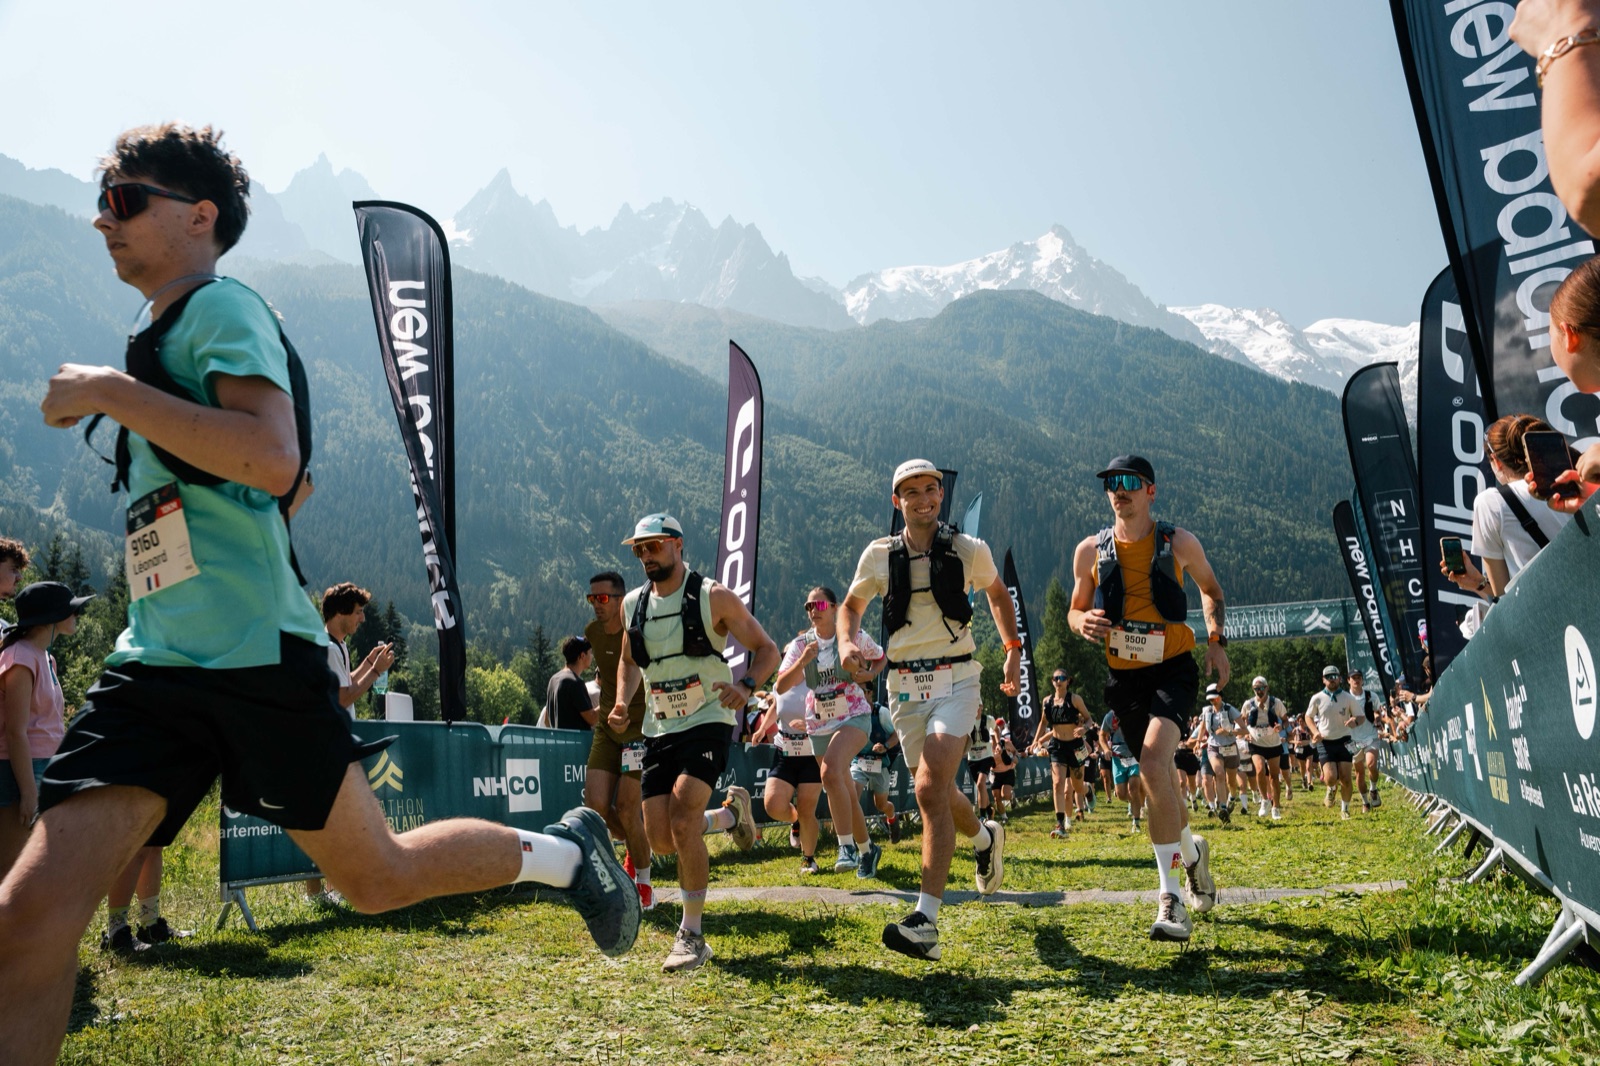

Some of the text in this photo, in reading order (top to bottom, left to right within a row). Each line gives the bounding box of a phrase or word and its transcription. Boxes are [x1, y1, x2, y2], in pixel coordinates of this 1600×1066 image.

[1444, 0, 1537, 112] ew
[1389, 499, 1406, 517] N
[131, 530, 160, 557] 9160
[1399, 538, 1415, 557] H
[133, 549, 168, 576] Léonard
[1345, 536, 1370, 580] new
[1408, 578, 1423, 596] C
[1124, 635, 1147, 645] 9500
[914, 673, 934, 684] 9010
[667, 692, 688, 703] 9703
[473, 775, 540, 797] NHCO
[1563, 771, 1588, 815] La
[590, 849, 618, 894] HOKA
